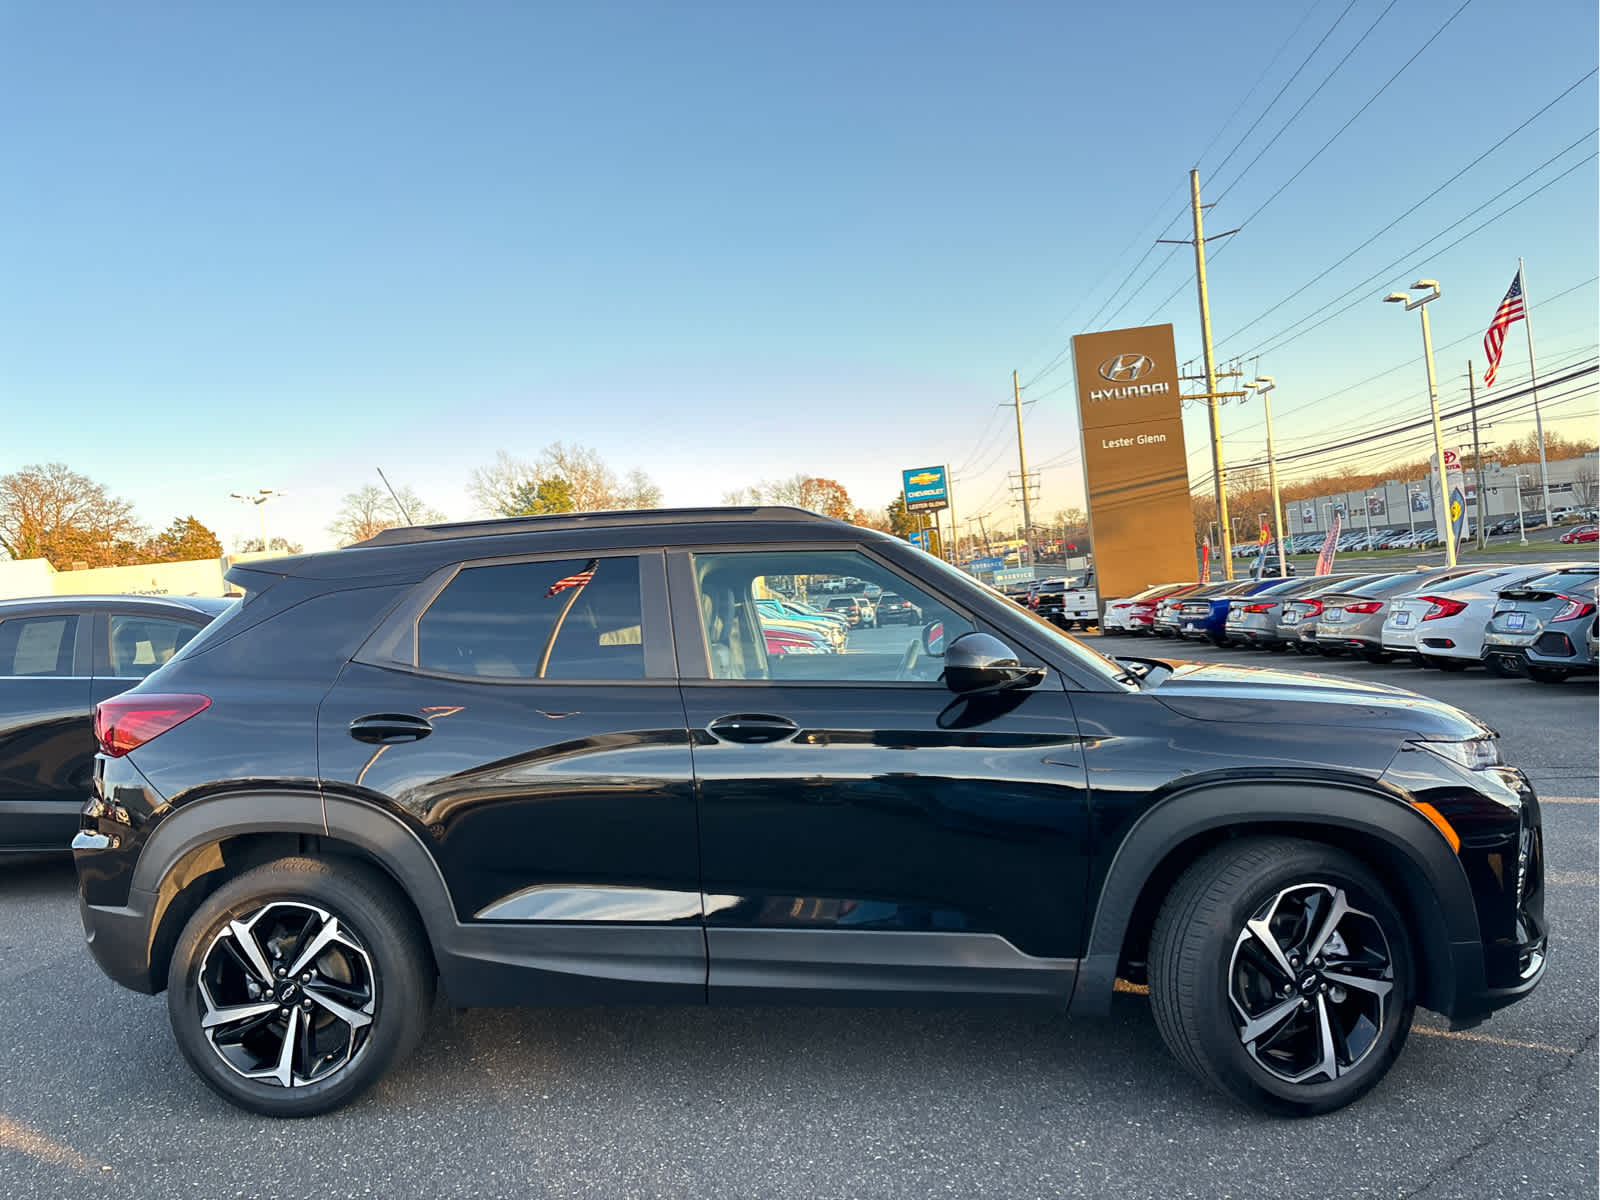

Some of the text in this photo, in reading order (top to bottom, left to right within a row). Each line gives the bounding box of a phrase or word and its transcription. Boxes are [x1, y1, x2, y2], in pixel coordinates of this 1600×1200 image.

[1090, 382, 1169, 402] HYUNDAI
[1102, 434, 1166, 449] Lester Glenn
[908, 488, 944, 498] CHEVROLET
[1003, 572, 1033, 580] SERVICE
